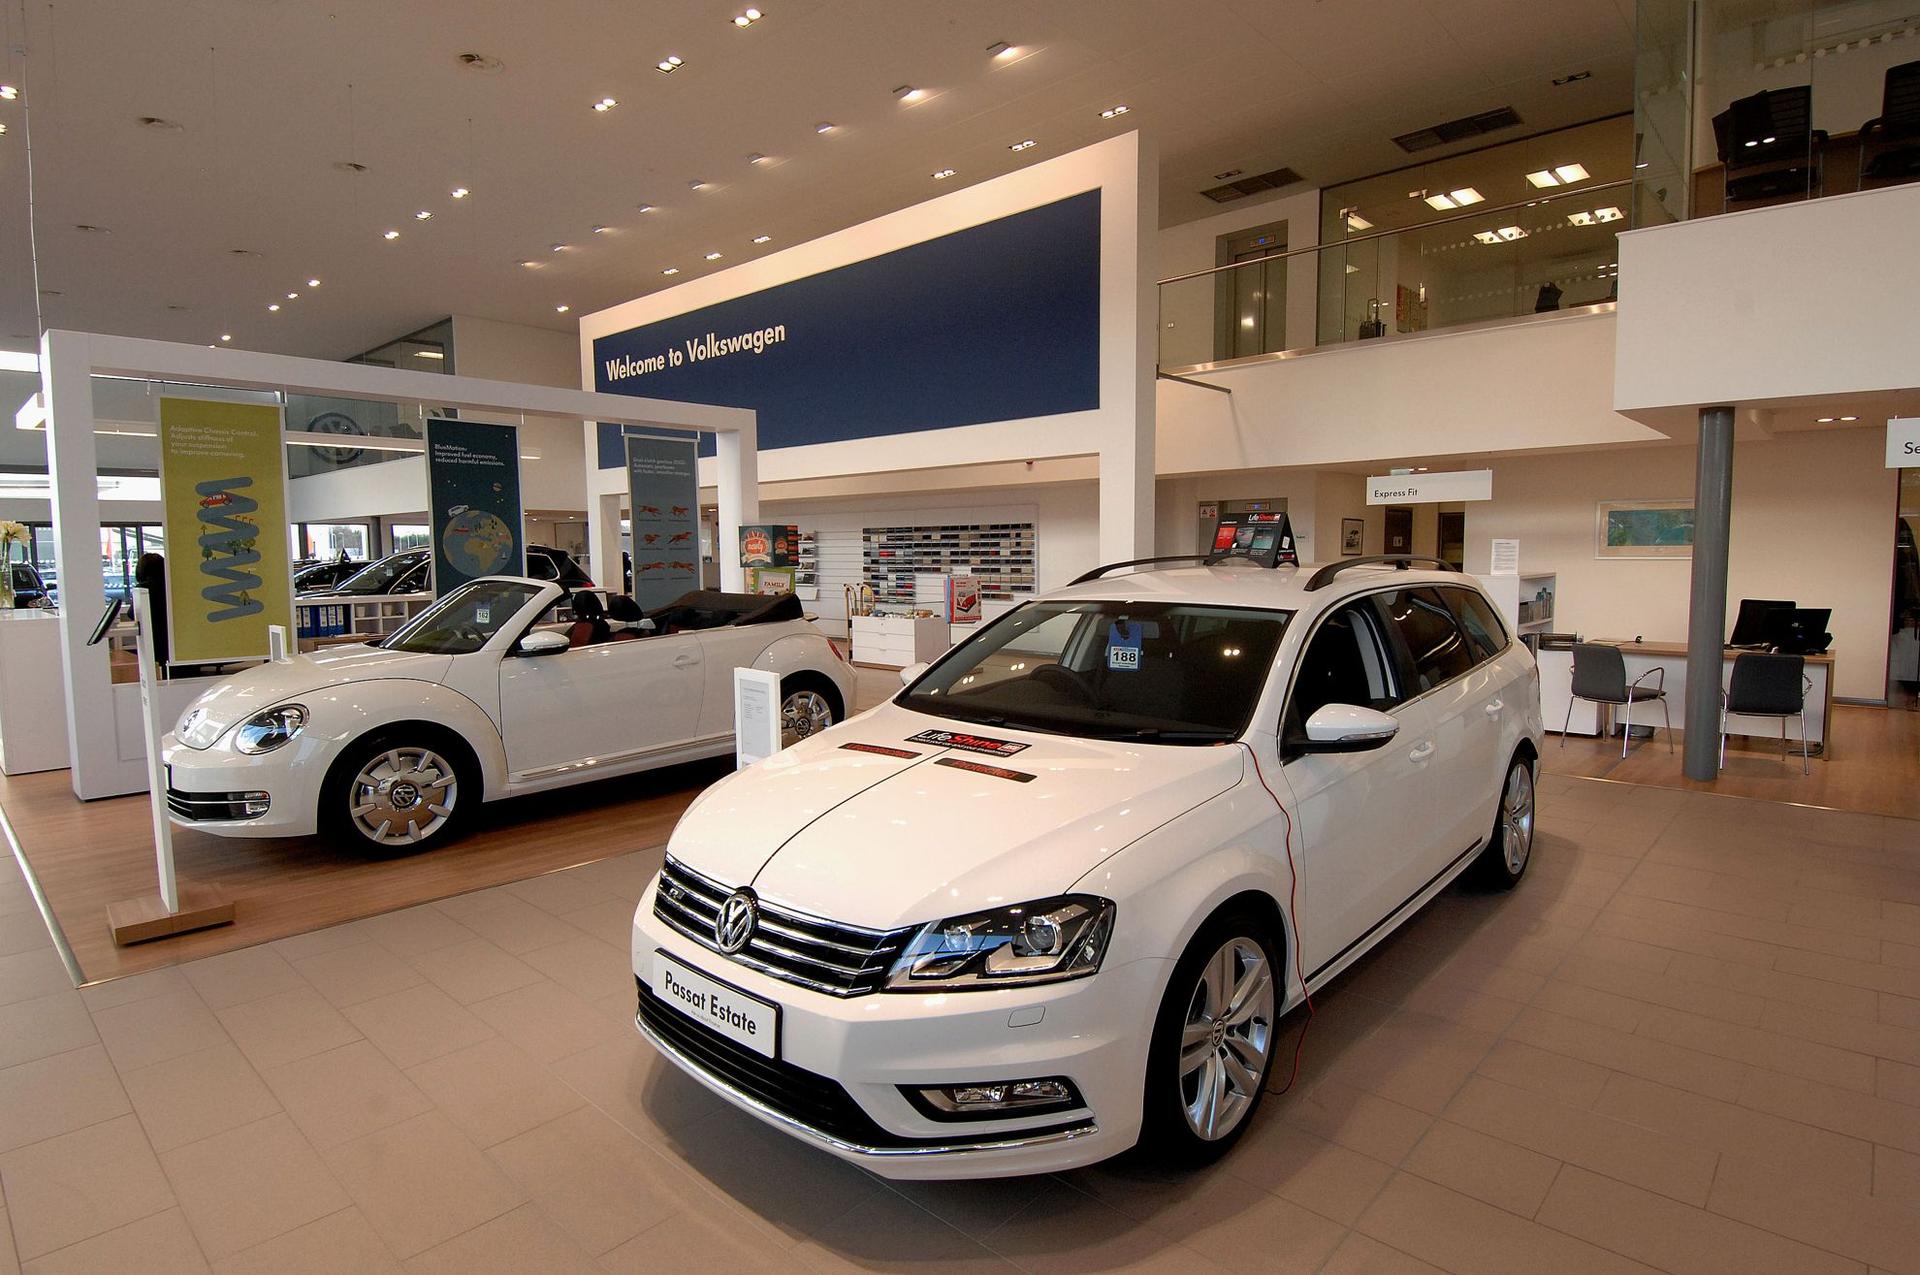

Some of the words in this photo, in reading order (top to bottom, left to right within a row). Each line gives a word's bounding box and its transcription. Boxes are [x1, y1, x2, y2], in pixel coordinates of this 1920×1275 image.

[606, 355, 665, 381] Welcome
[668, 348, 683, 367] to
[686, 324, 786, 363] Volkswagen
[1374, 489, 1406, 499] Express
[1407, 488, 1418, 497] Fit
[1113, 651, 1136, 662] 188
[952, 759, 1020, 778] Protected
[665, 970, 706, 1010] Passat
[710, 994, 757, 1035] Estate
